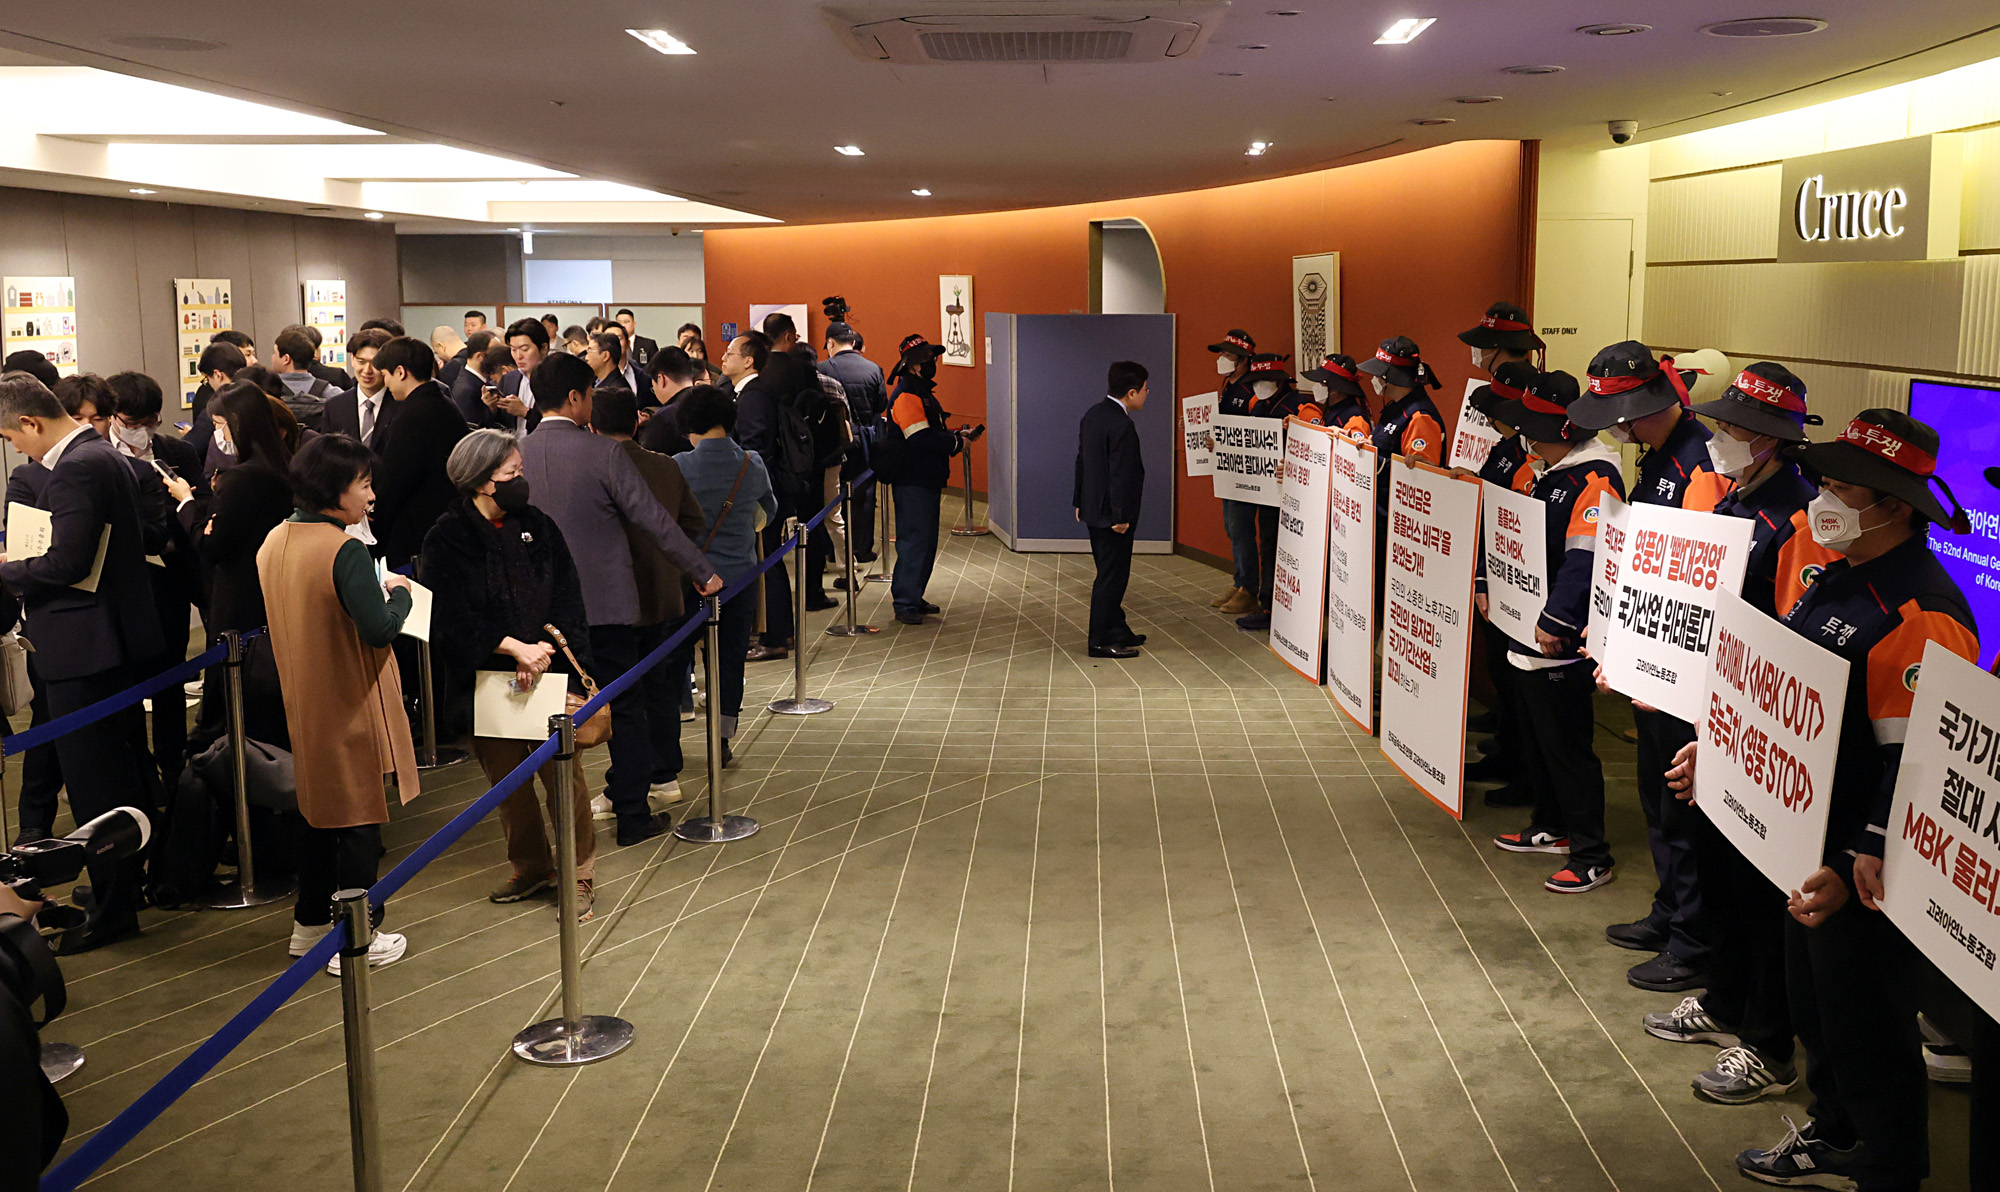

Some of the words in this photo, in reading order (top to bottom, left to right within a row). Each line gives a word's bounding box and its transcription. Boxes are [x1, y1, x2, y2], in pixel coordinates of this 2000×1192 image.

[1795, 174, 1908, 241] Cruce
[1541, 327, 1560, 335] STAFF
[1561, 327, 1578, 335] ONLY
[1750, 379, 1784, 403] 투쟁
[1244, 428, 1279, 451] 절대사수!!
[1861, 428, 1903, 457] 투쟁
[1216, 452, 1244, 474] 고려아연
[1395, 480, 1432, 515] 국민연금은
[1656, 478, 1676, 500] 투쟁
[1497, 506, 1521, 535] 홈플러스
[1495, 531, 1506, 555] 망친
[1632, 529, 1669, 578] 영풍의
[1928, 537, 1942, 552] The
[1943, 541, 1962, 559] 52nd
[1961, 547, 1989, 567] Annual
[1392, 541, 1425, 579] 잊었는가!!
[1286, 572, 1301, 597] M&A
[1975, 572, 1985, 586] of
[1390, 600, 1410, 633] 국민의
[1406, 587, 1424, 610] 소중한
[1425, 596, 1460, 628] 노후자금이
[1618, 585, 1664, 640] 국가산업
[1821, 616, 1858, 646] 투쟁
[1635, 658, 1678, 685] 고려아연노동조합
[1716, 625, 1751, 696] 하이에나
[1707, 690, 1743, 765] 무능극치
[1938, 700, 2000, 784] 국가기
[1723, 788, 1767, 841] 고려아연노동조합
[1940, 766, 1986, 834] 절대
[1902, 801, 1955, 877] MBK
[1952, 841, 2000, 916] 물러
[1926, 898, 1997, 971] 고려아연노동조합
